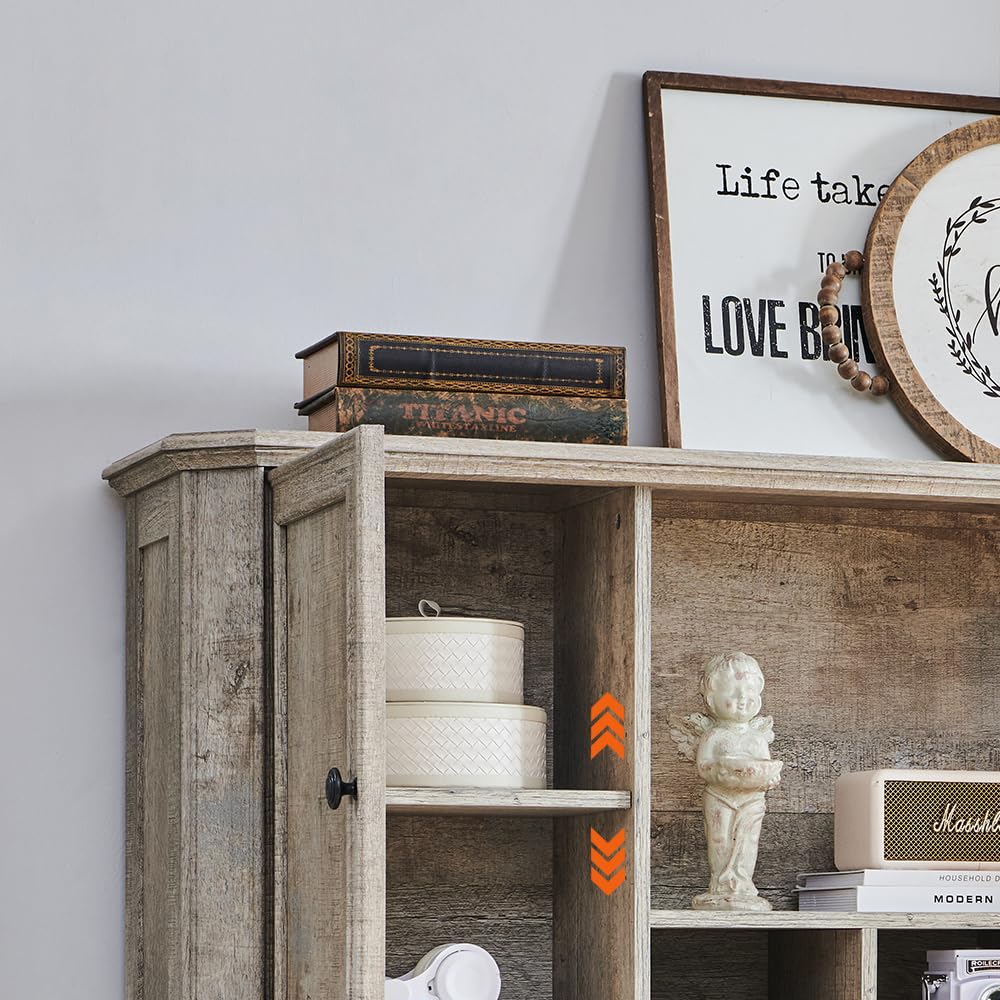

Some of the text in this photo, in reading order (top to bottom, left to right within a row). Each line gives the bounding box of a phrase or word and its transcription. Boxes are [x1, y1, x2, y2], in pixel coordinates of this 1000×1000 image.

[715, 163, 800, 201] Life
[701, 294, 789, 359] LOVE
[399, 403, 527, 425] TITANIC
[938, 874, 992, 882] HOUSEHOLD
[934, 894, 993, 904] MODERN
